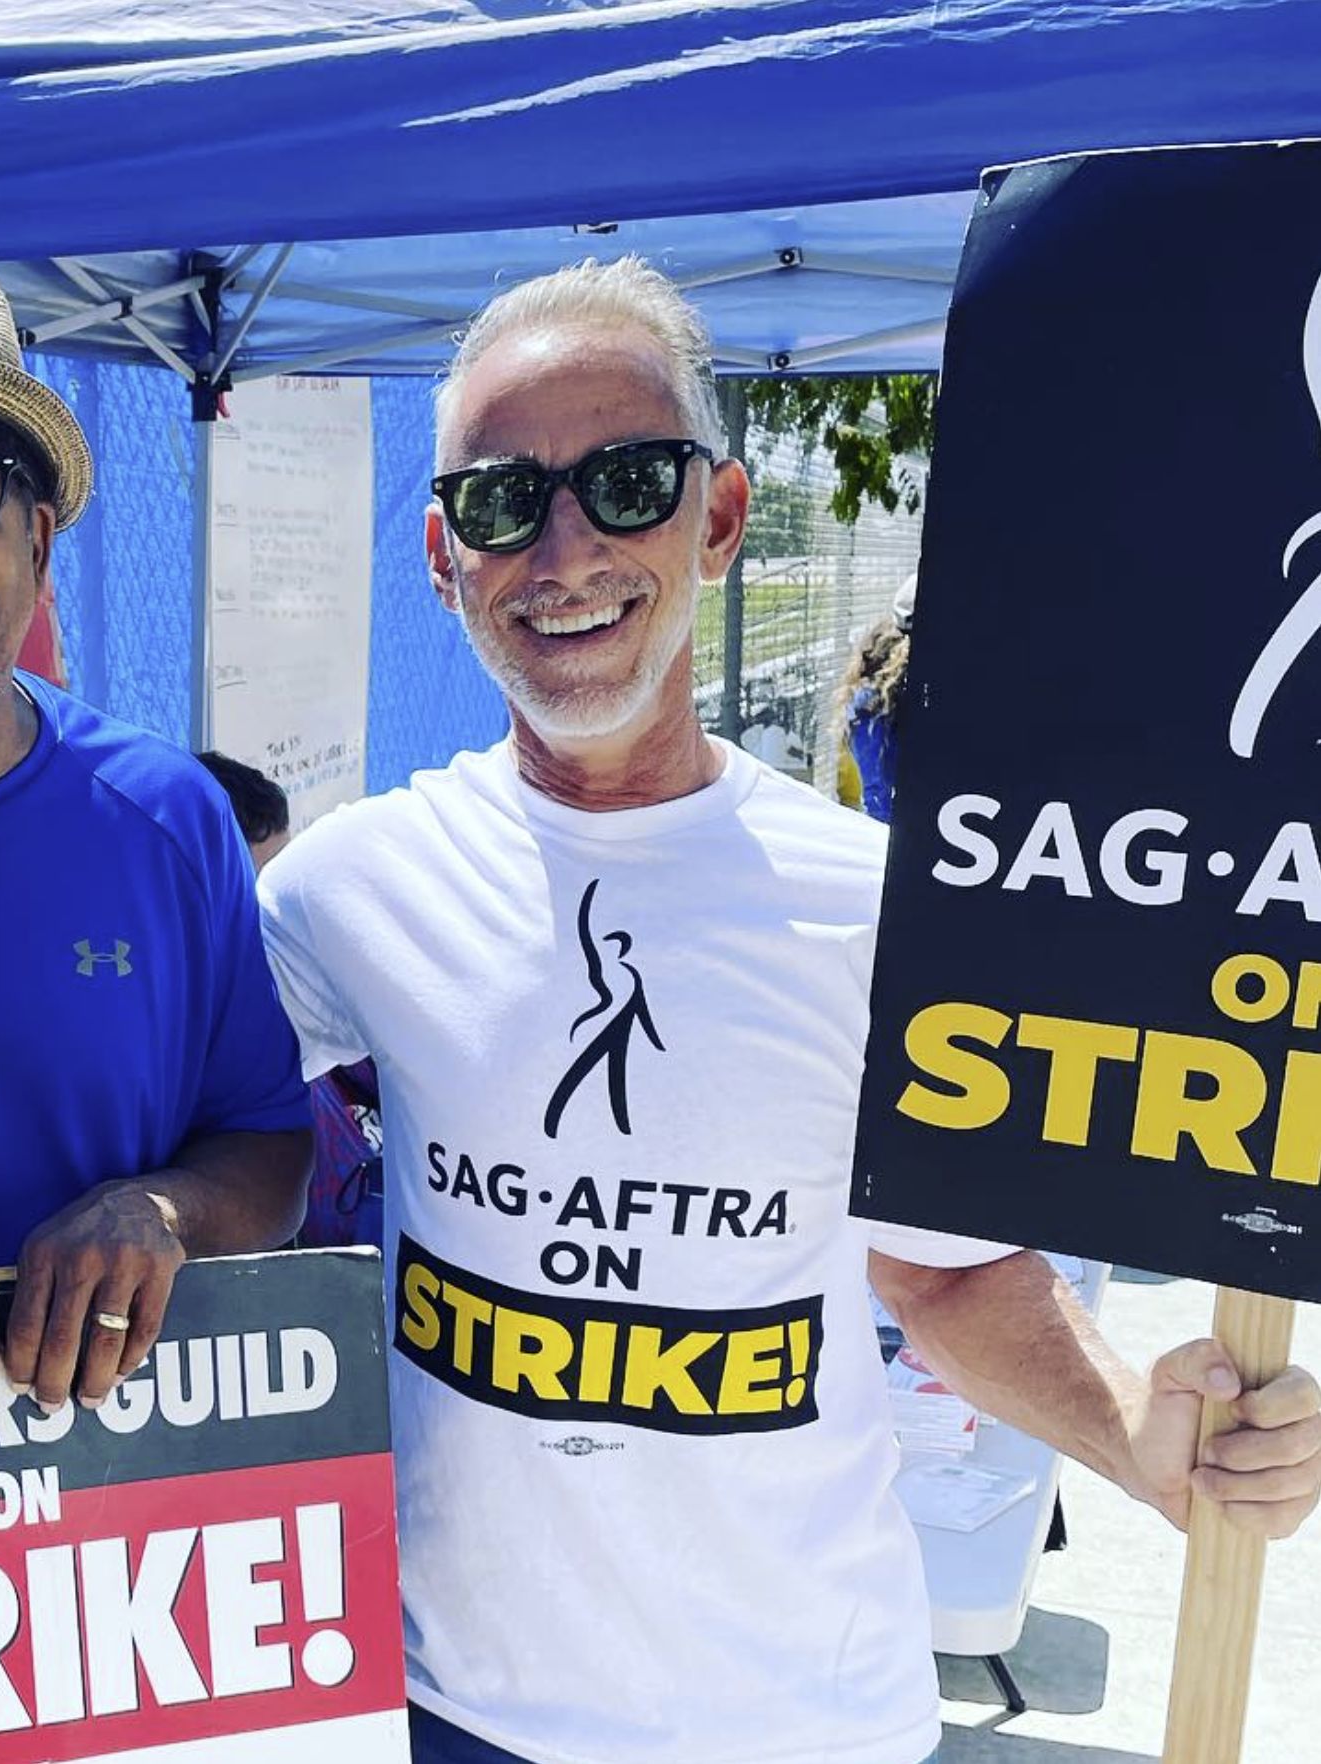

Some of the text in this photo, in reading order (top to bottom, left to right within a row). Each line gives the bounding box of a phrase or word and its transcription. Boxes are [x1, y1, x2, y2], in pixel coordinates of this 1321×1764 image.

[539, 1240, 642, 1291] ON
[95, 1327, 339, 1434] GUILD
[401, 1262, 810, 1416] STRIKE!
